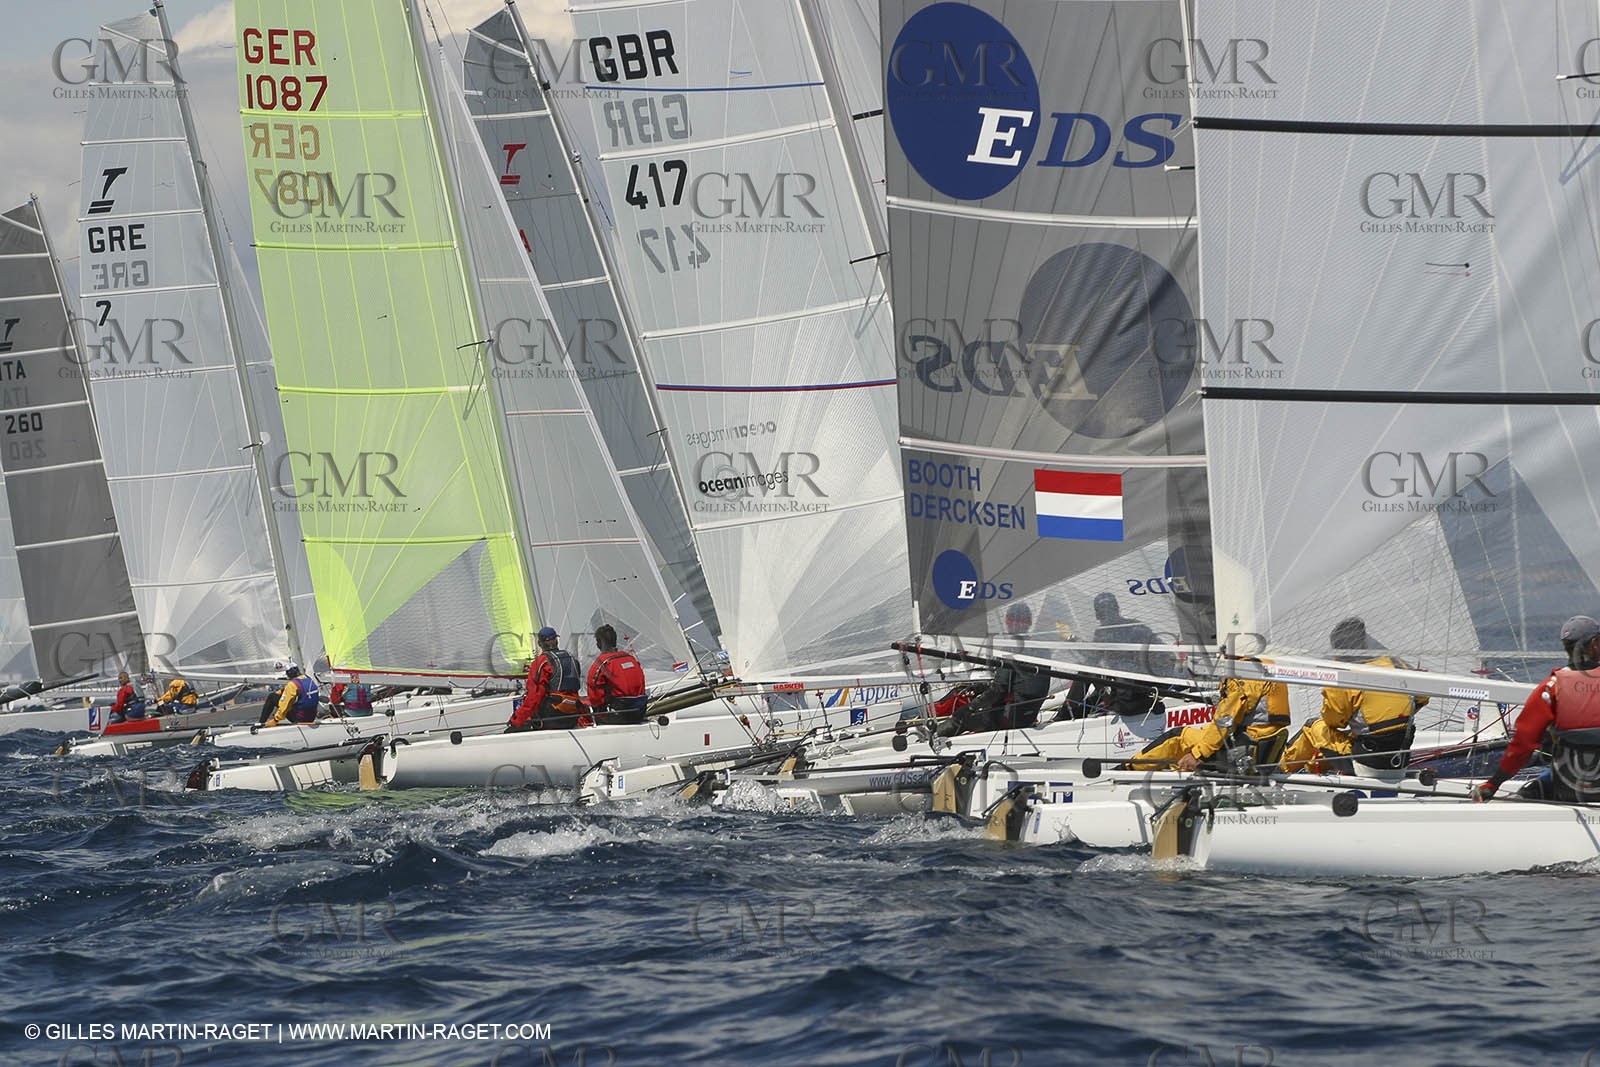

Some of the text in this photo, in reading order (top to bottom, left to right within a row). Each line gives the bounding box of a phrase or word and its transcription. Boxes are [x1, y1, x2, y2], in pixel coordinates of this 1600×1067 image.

[243, 28, 316, 66] GER
[588, 29, 680, 83] GBR
[246, 74, 328, 111] 1087
[966, 107, 1183, 169] EDS
[625, 159, 688, 210] 417
[87, 223, 147, 254] GRE
[95, 300, 112, 327] 7
[0, 359, 27, 382] TA
[5, 411, 44, 435] 260
[699, 470, 789, 494] oceanimages
[908, 459, 981, 492] BOOTH
[910, 492, 1026, 531] DERCKSEN
[957, 579, 1014, 600] EDS
[1167, 707, 1213, 728] HARK
